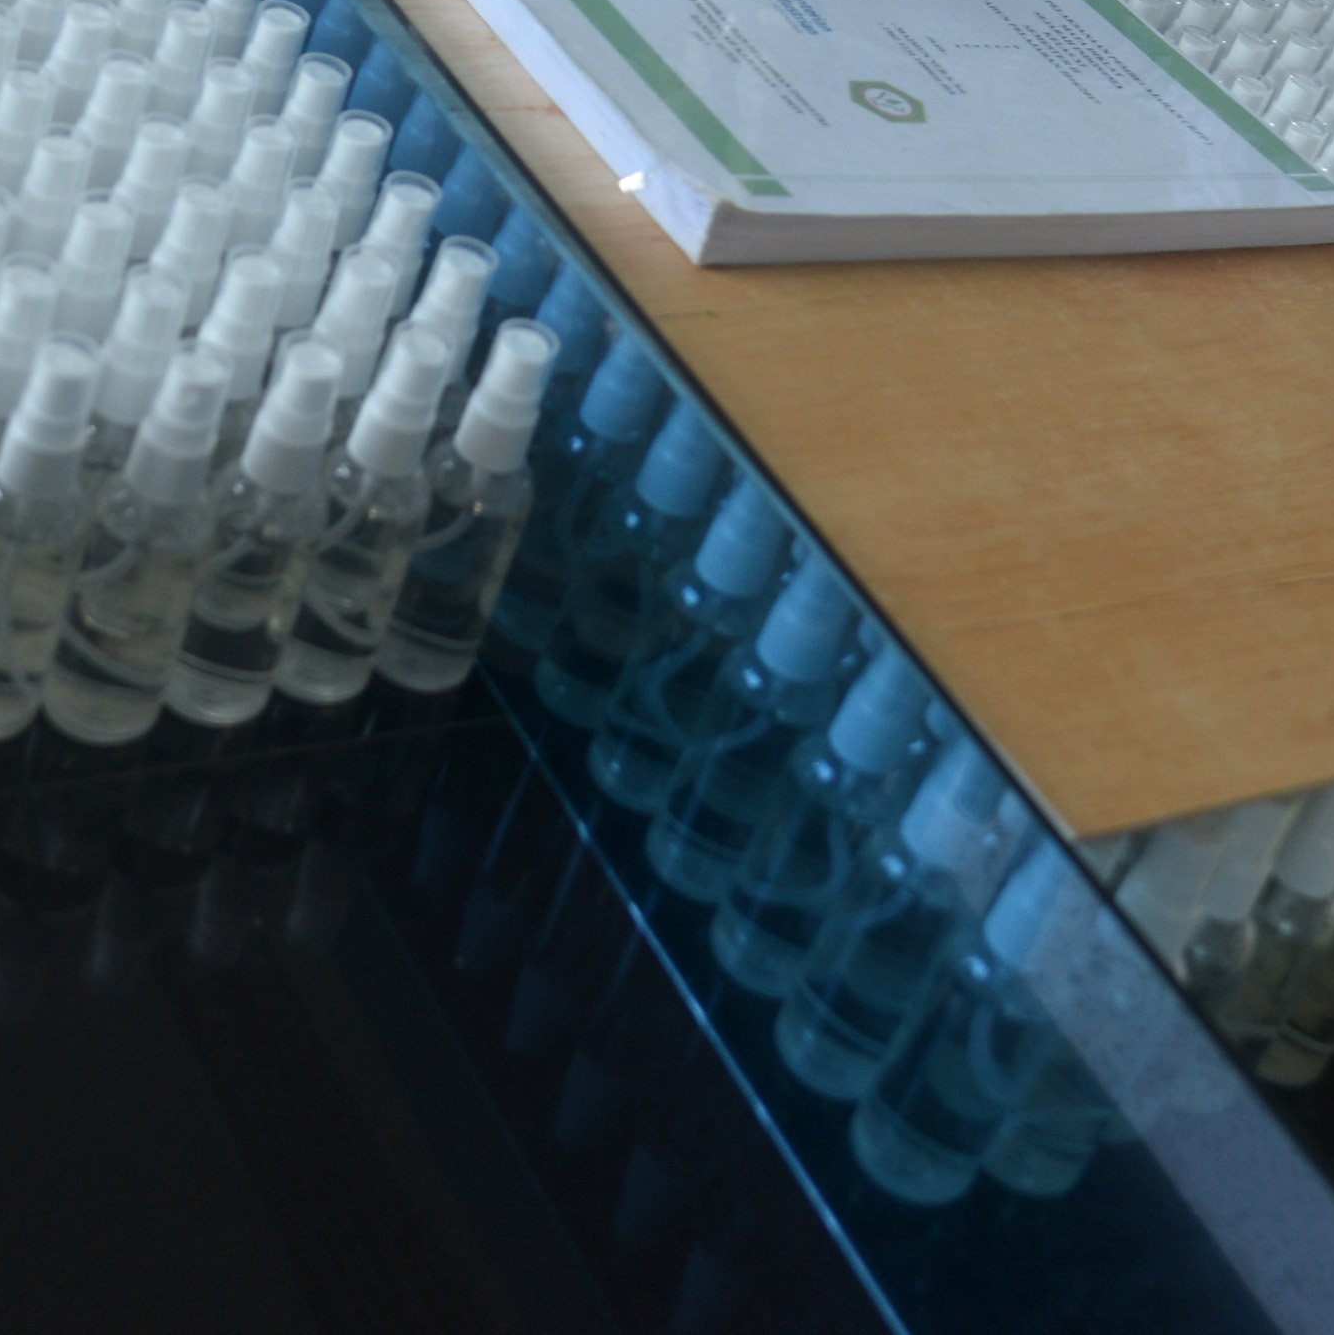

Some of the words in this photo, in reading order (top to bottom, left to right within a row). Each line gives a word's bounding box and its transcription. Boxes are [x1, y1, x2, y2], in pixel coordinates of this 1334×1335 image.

[1007, 23, 1061, 67] PELAJARAN
[1022, 24, 1071, 65] SEMESTER
[1042, 31, 1076, 57] KELAS
[1044, 0, 1110, 53] PELAKSANAAN
[1032, 11, 1075, 45] SEJARAH
[1072, 47, 1124, 89] INDONESIA
